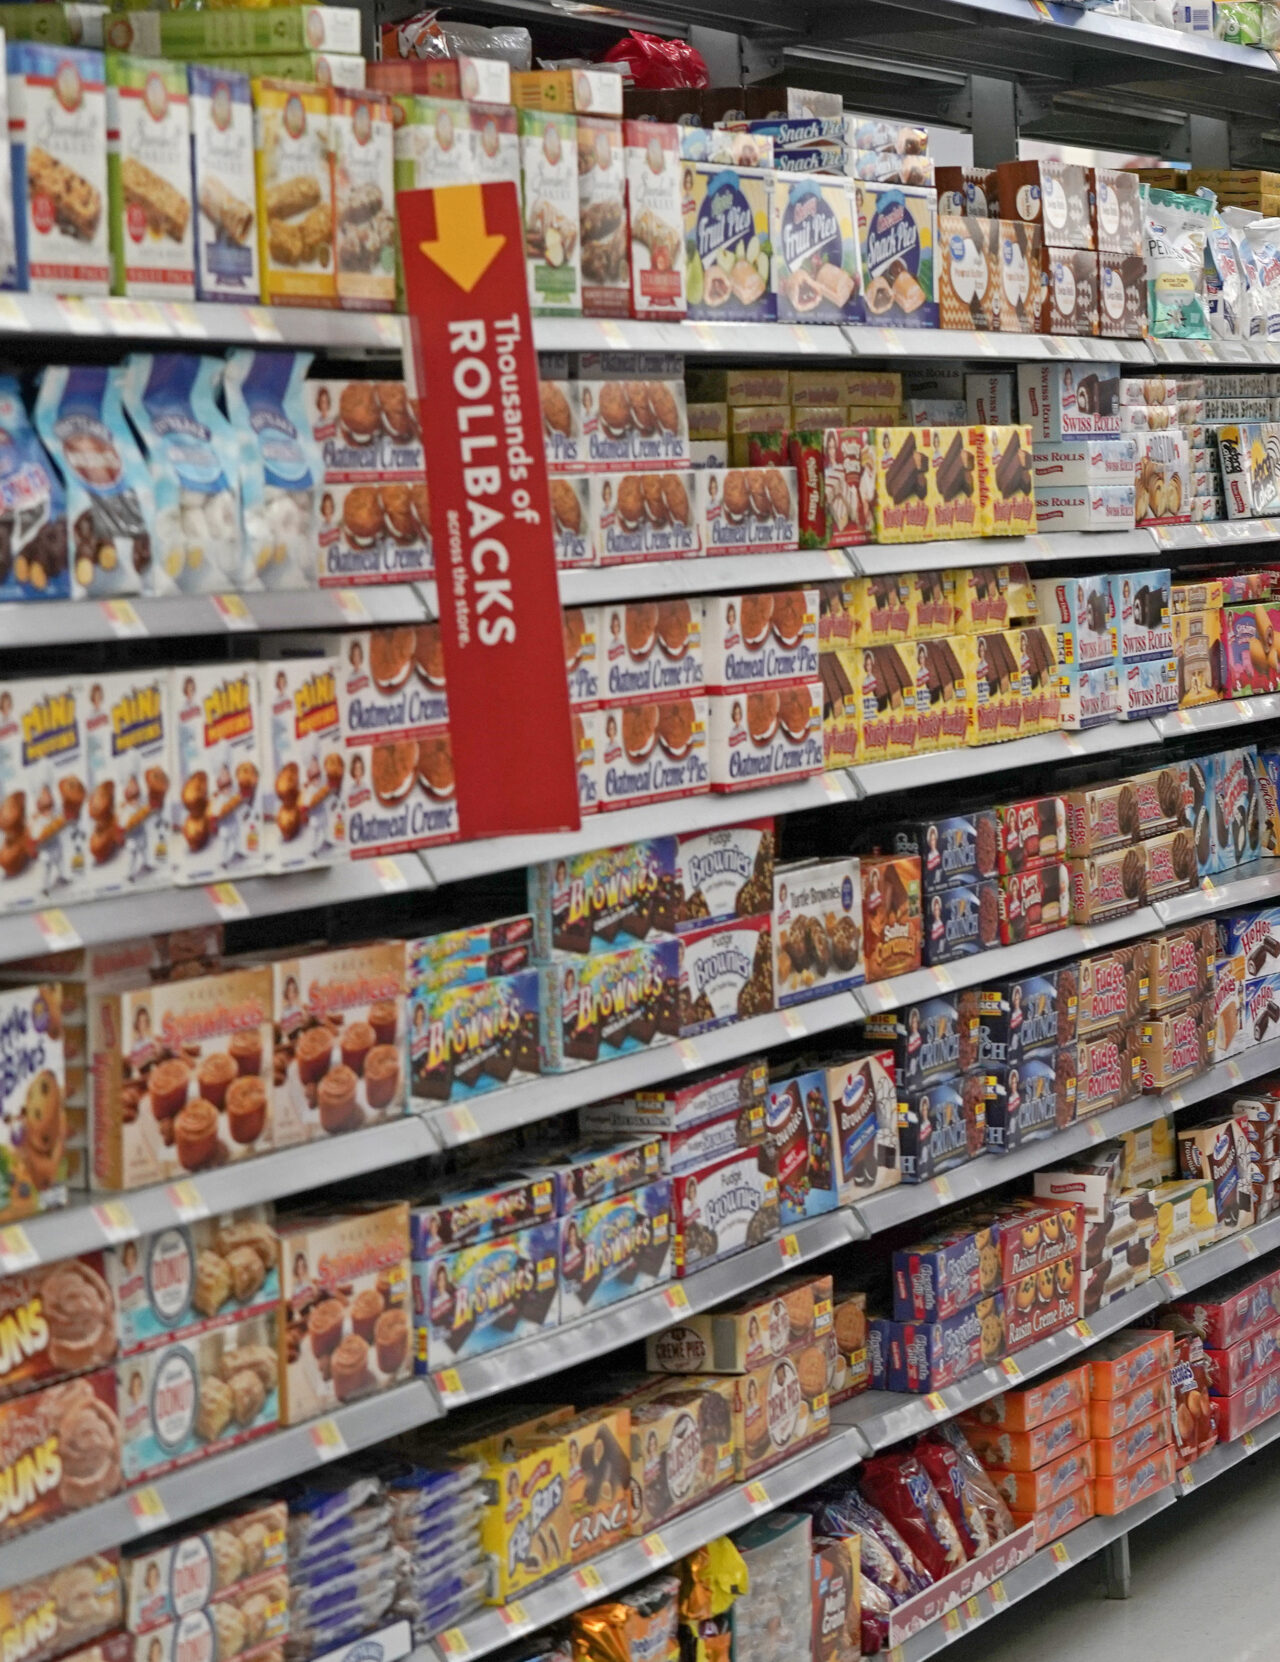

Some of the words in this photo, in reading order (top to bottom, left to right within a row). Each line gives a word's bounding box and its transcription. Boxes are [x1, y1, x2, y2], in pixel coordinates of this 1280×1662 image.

[777, 121, 819, 142] Snack
[778, 152, 820, 171] Snack
[727, 206, 751, 235] Pies
[783, 222, 810, 254] Fruit
[811, 211, 837, 242] Pies
[868, 232, 896, 266] Snack
[896, 223, 917, 254] Pies
[494, 313, 534, 482] Thousands
[1063, 414, 1093, 433] SWISS
[1094, 412, 1123, 431] ROLLS
[1051, 453, 1085, 462] ROLLS
[448, 319, 516, 646] ROLLBACKS
[511, 489, 540, 525] of
[1051, 498, 1085, 507] ROLLS
[447, 509, 463, 565] across
[452, 566, 468, 597] the
[455, 599, 470, 649] store.
[1123, 633, 1147, 655] SWISS
[1147, 630, 1173, 651] ROLLS
[608, 662, 650, 693] Oatmeal
[651, 655, 684, 689] Creme
[725, 651, 766, 681] Oatmeal
[767, 647, 797, 676] Creme
[797, 645, 817, 672] Pies
[1128, 688, 1154, 709] SWISS
[1155, 684, 1180, 705] ROLLS
[348, 699, 405, 730] Oatmeal
[729, 747, 772, 778] Oatmeal
[773, 743, 803, 772] Creme
[803, 738, 823, 766] Pies
[605, 763, 650, 796] Oatmeal
[653, 759, 686, 790] Creme
[686, 755, 708, 784] Pies
[348, 811, 406, 843] Oatmeal
[411, 802, 457, 832] Creme
[688, 846, 752, 891] Brownies
[790, 889, 810, 909] Turtle
[811, 882, 841, 904] Brownies
[694, 947, 751, 992] Brownies
[1170, 940, 1196, 968] Fudge
[1094, 962, 1126, 995] Fudge
[1092, 989, 1128, 1022] Rounds
[866, 1024, 895, 1034] PACK
[1091, 1043, 1119, 1072] Fudge
[1087, 1070, 1122, 1099] Rounds
[704, 1187, 761, 1229] Brownies
[1012, 1250, 1036, 1275] Raisin
[1037, 1242, 1063, 1264] Creme
[1009, 1318, 1032, 1345] Raisin
[1032, 1306, 1058, 1332] Creme
[1058, 1300, 1075, 1321] Pies
